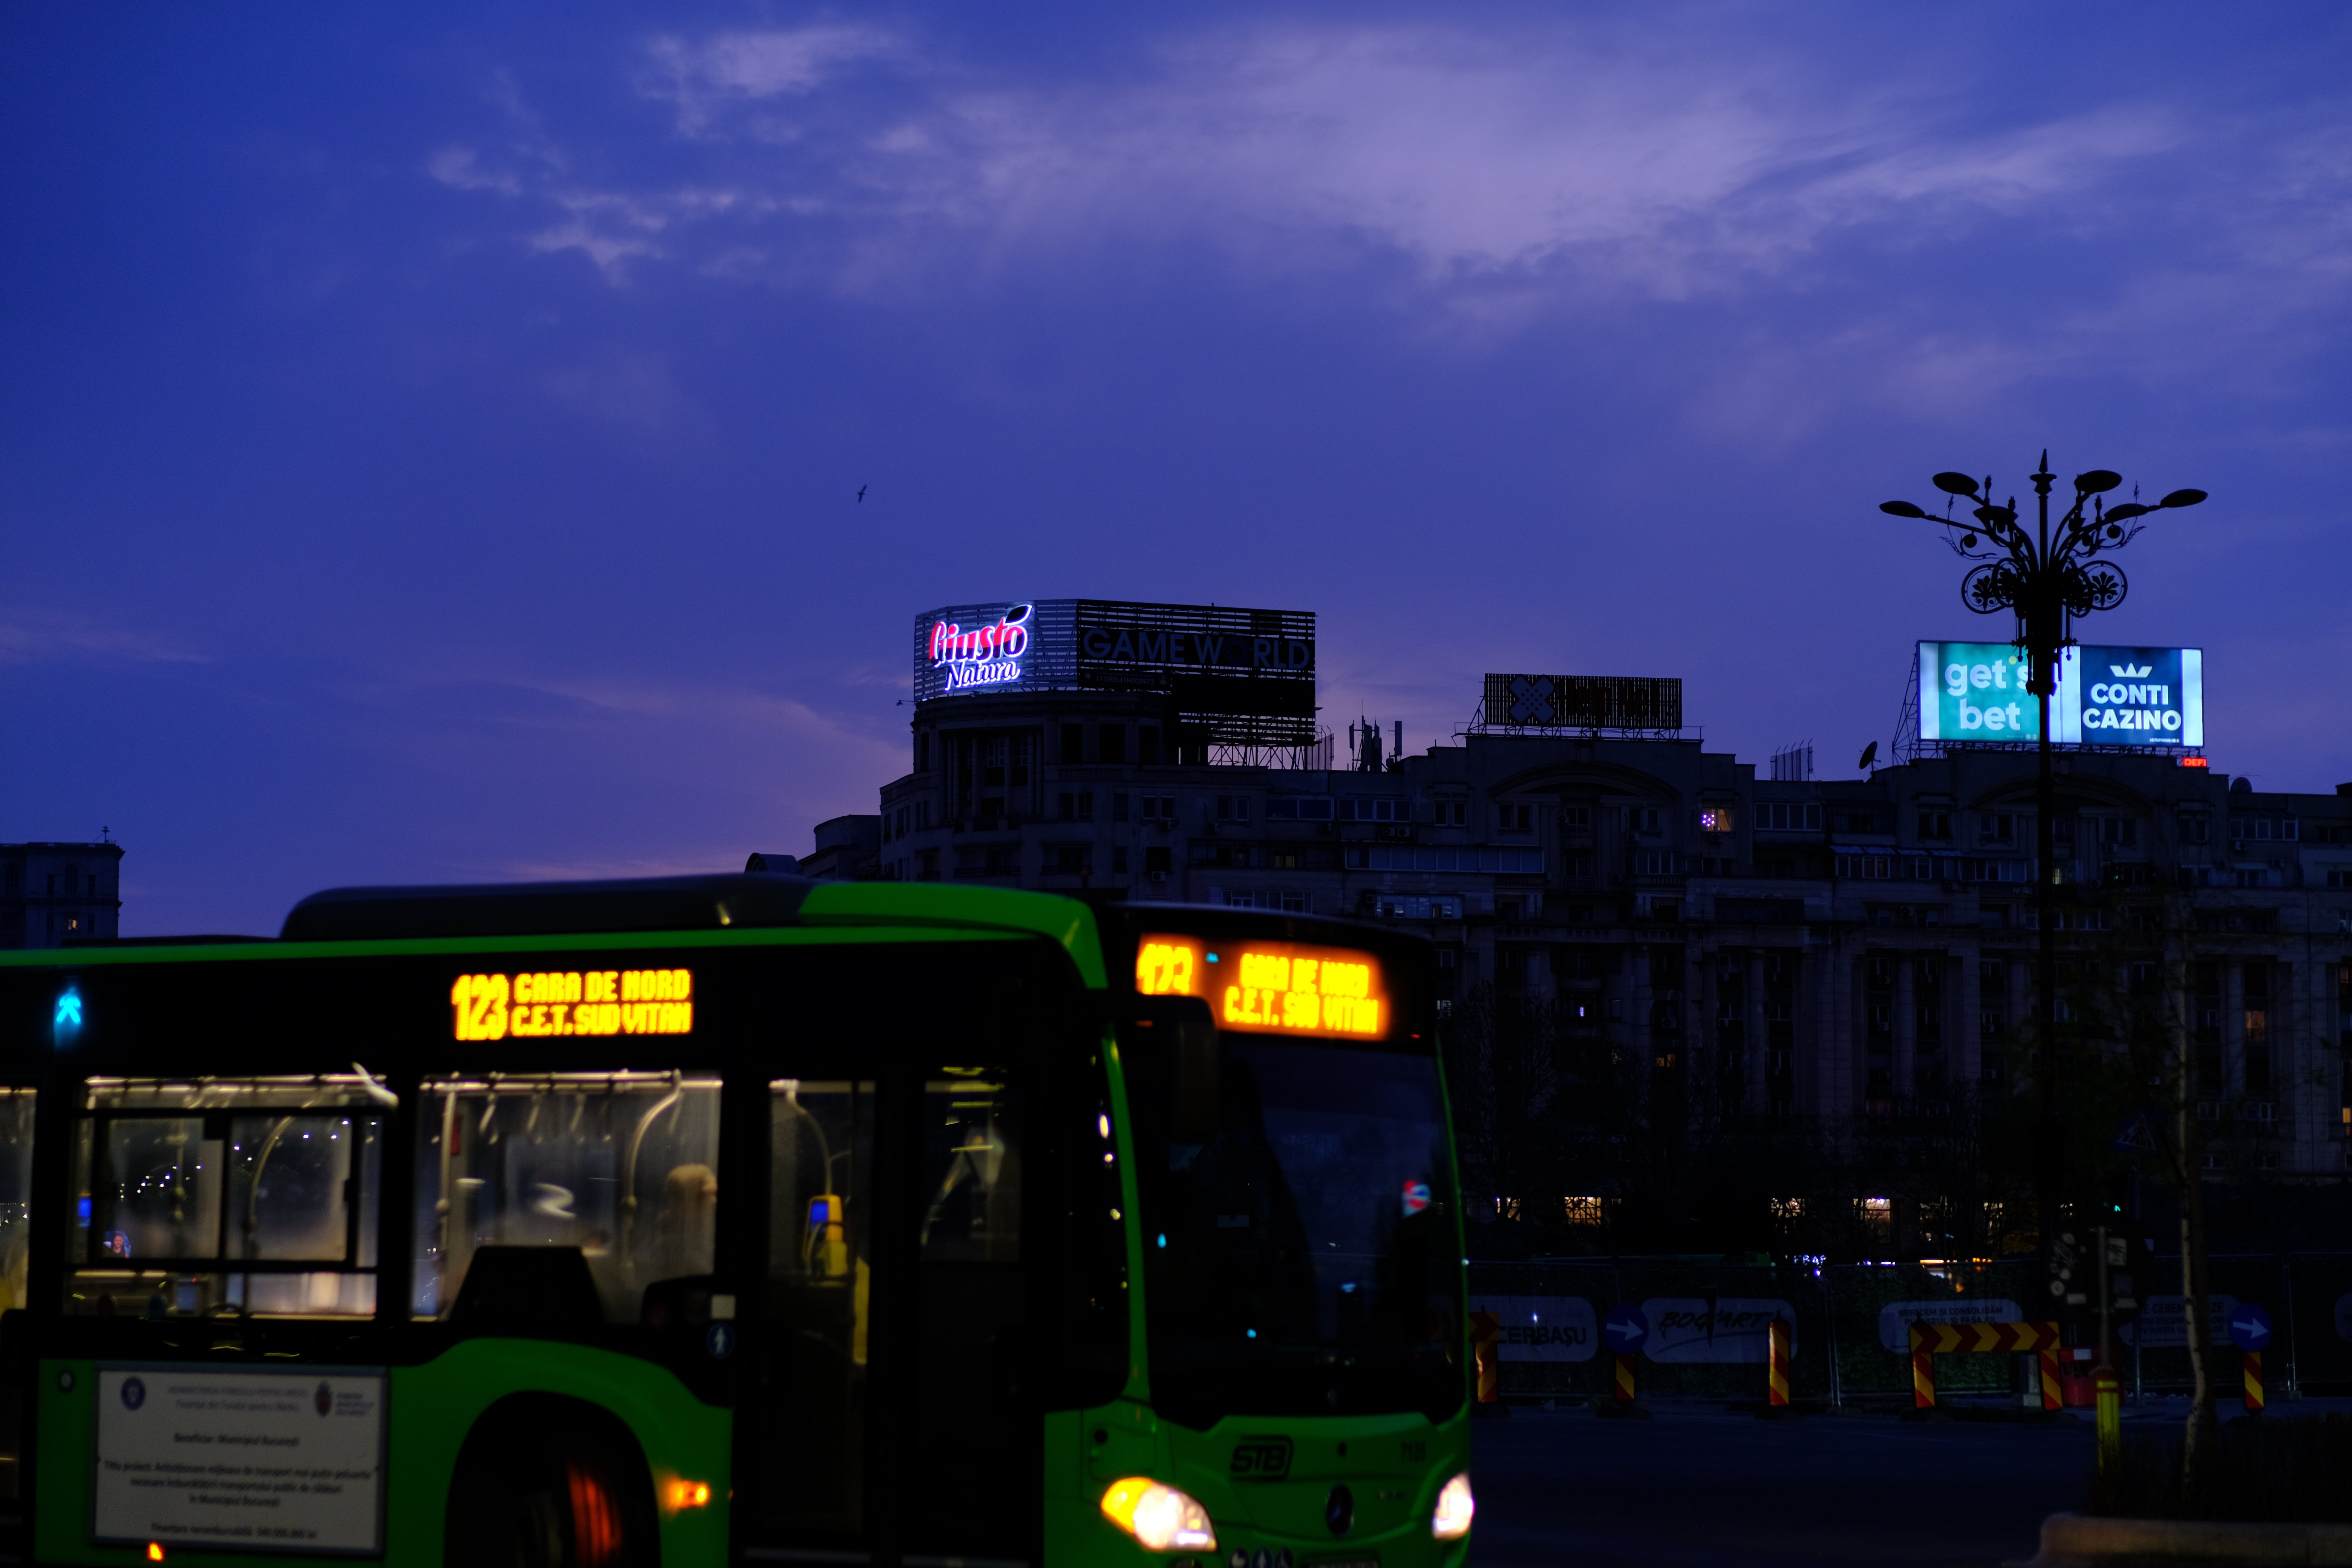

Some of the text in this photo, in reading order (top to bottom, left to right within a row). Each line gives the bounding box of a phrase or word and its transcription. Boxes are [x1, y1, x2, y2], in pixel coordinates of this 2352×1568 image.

[929, 617, 1028, 669] Giusto
[1083, 628, 1185, 664] GAME
[945, 660, 1021, 692] Natura
[2091, 683, 2169, 705] CONTI
[1961, 698, 2020, 731] bet
[2082, 709, 2182, 731] CAZINO
[514, 969, 690, 1003] GARA DE NORD
[452, 974, 509, 1040] 123
[1899, 1308, 1937, 1317] REFACEM
[1232, 1446, 1286, 1471] STB
